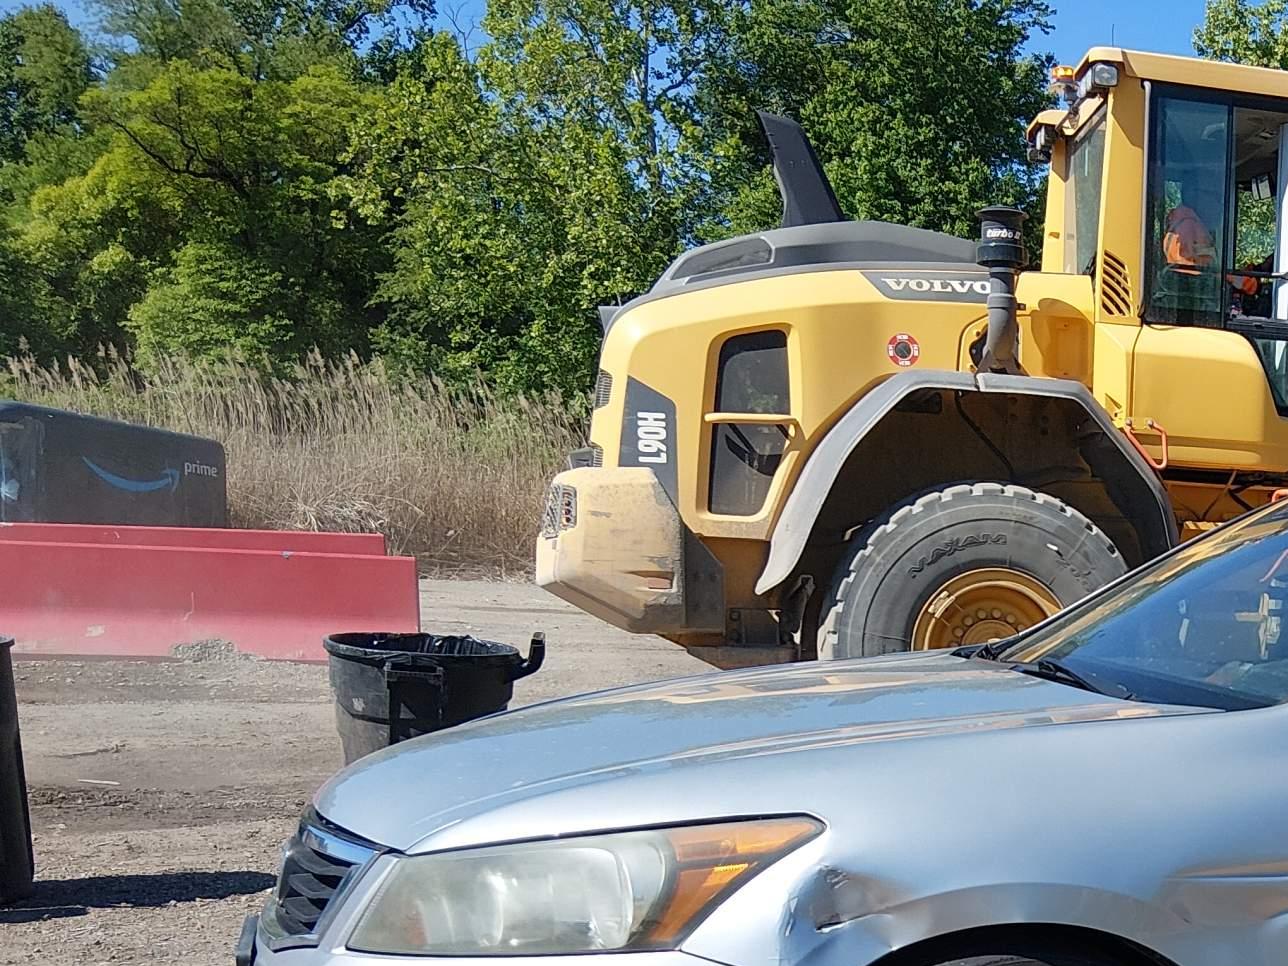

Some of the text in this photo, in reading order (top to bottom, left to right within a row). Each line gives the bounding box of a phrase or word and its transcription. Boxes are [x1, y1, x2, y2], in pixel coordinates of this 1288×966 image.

[881, 278, 992, 295] VOLVO
[637, 411, 667, 464] L90H
[184, 460, 218, 477] prime
